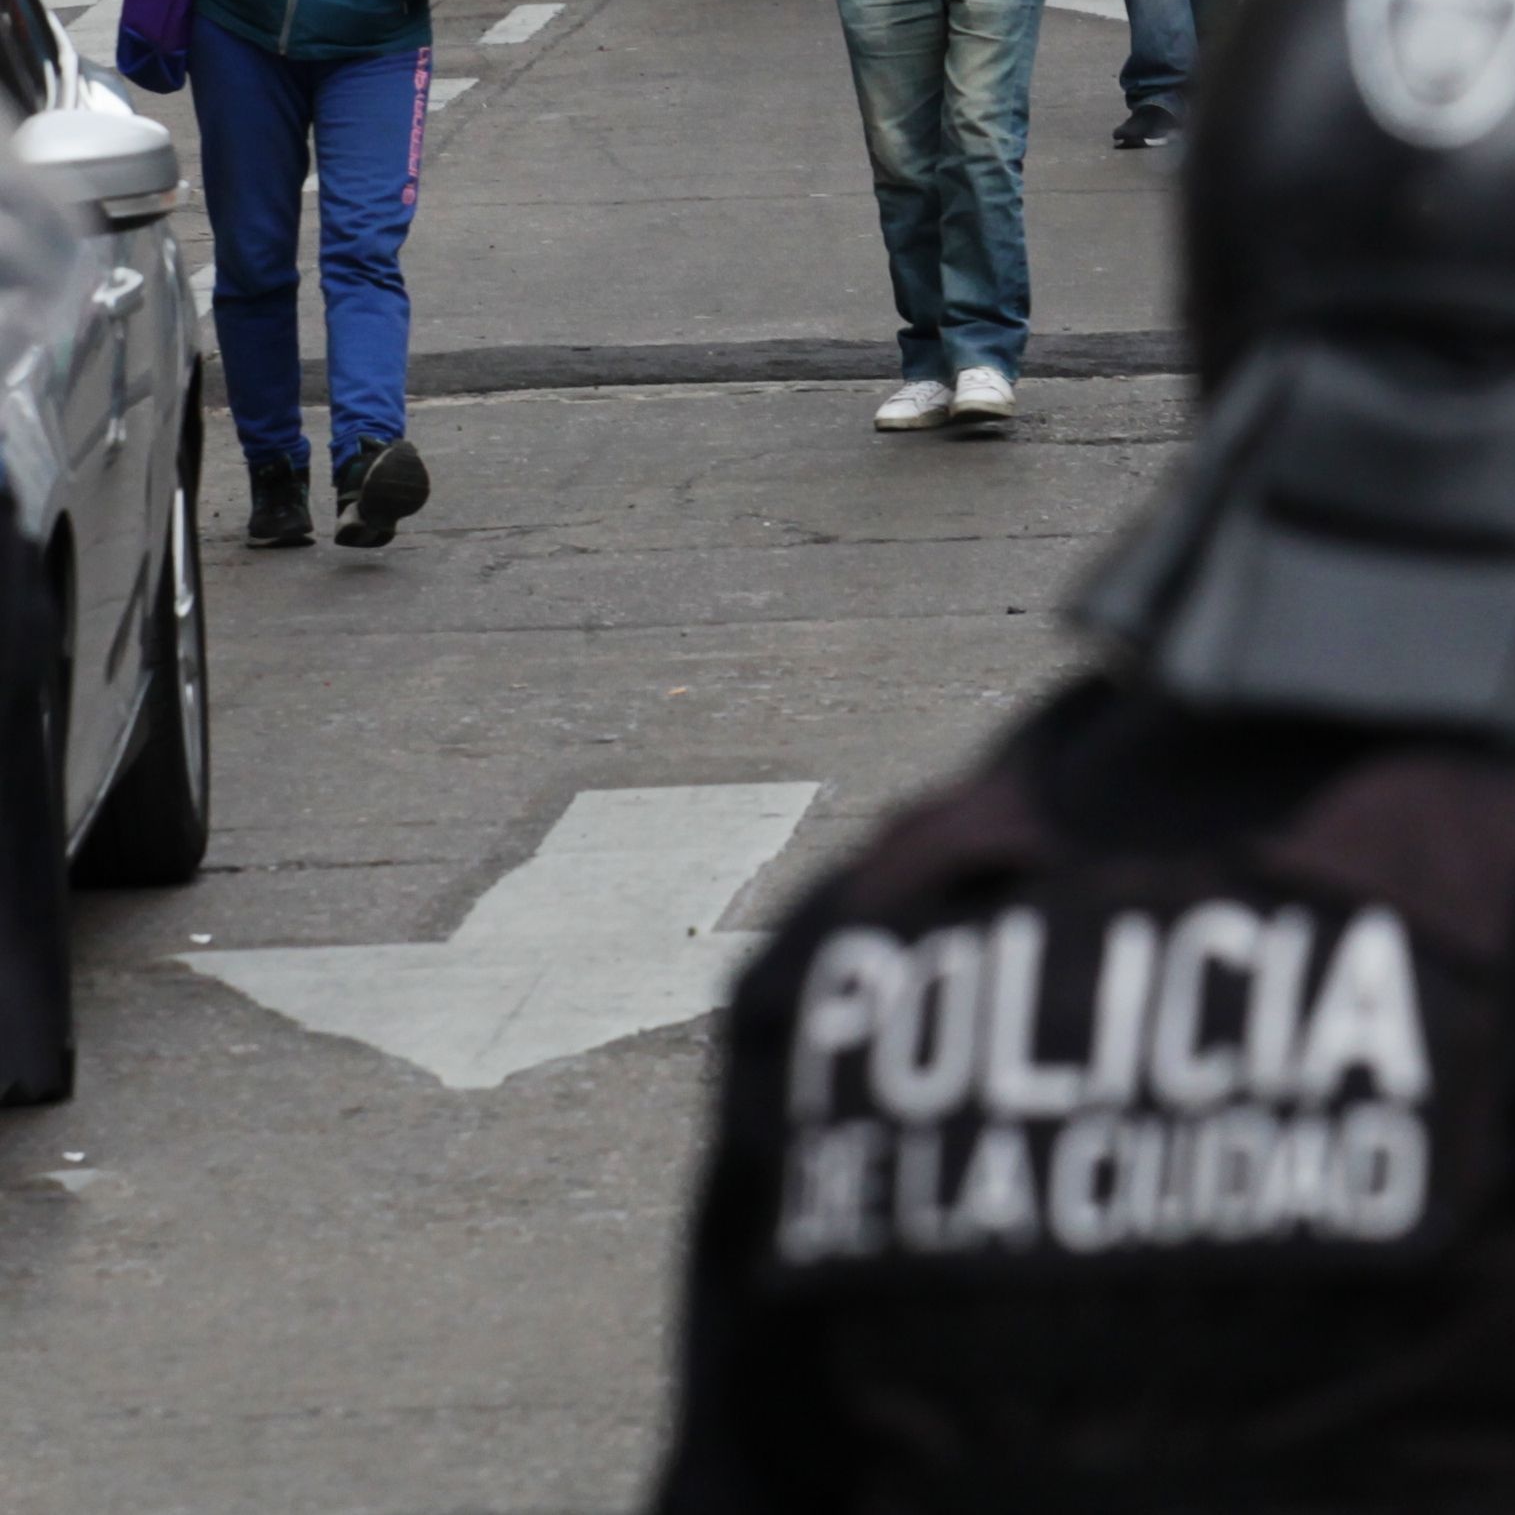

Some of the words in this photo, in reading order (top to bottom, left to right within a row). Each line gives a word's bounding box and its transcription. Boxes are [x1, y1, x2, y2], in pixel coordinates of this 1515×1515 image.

[788, 898, 1432, 1122] POLICIA
[895, 1118, 1038, 1252] LA
[1049, 1104, 1428, 1253] CIUDAD
